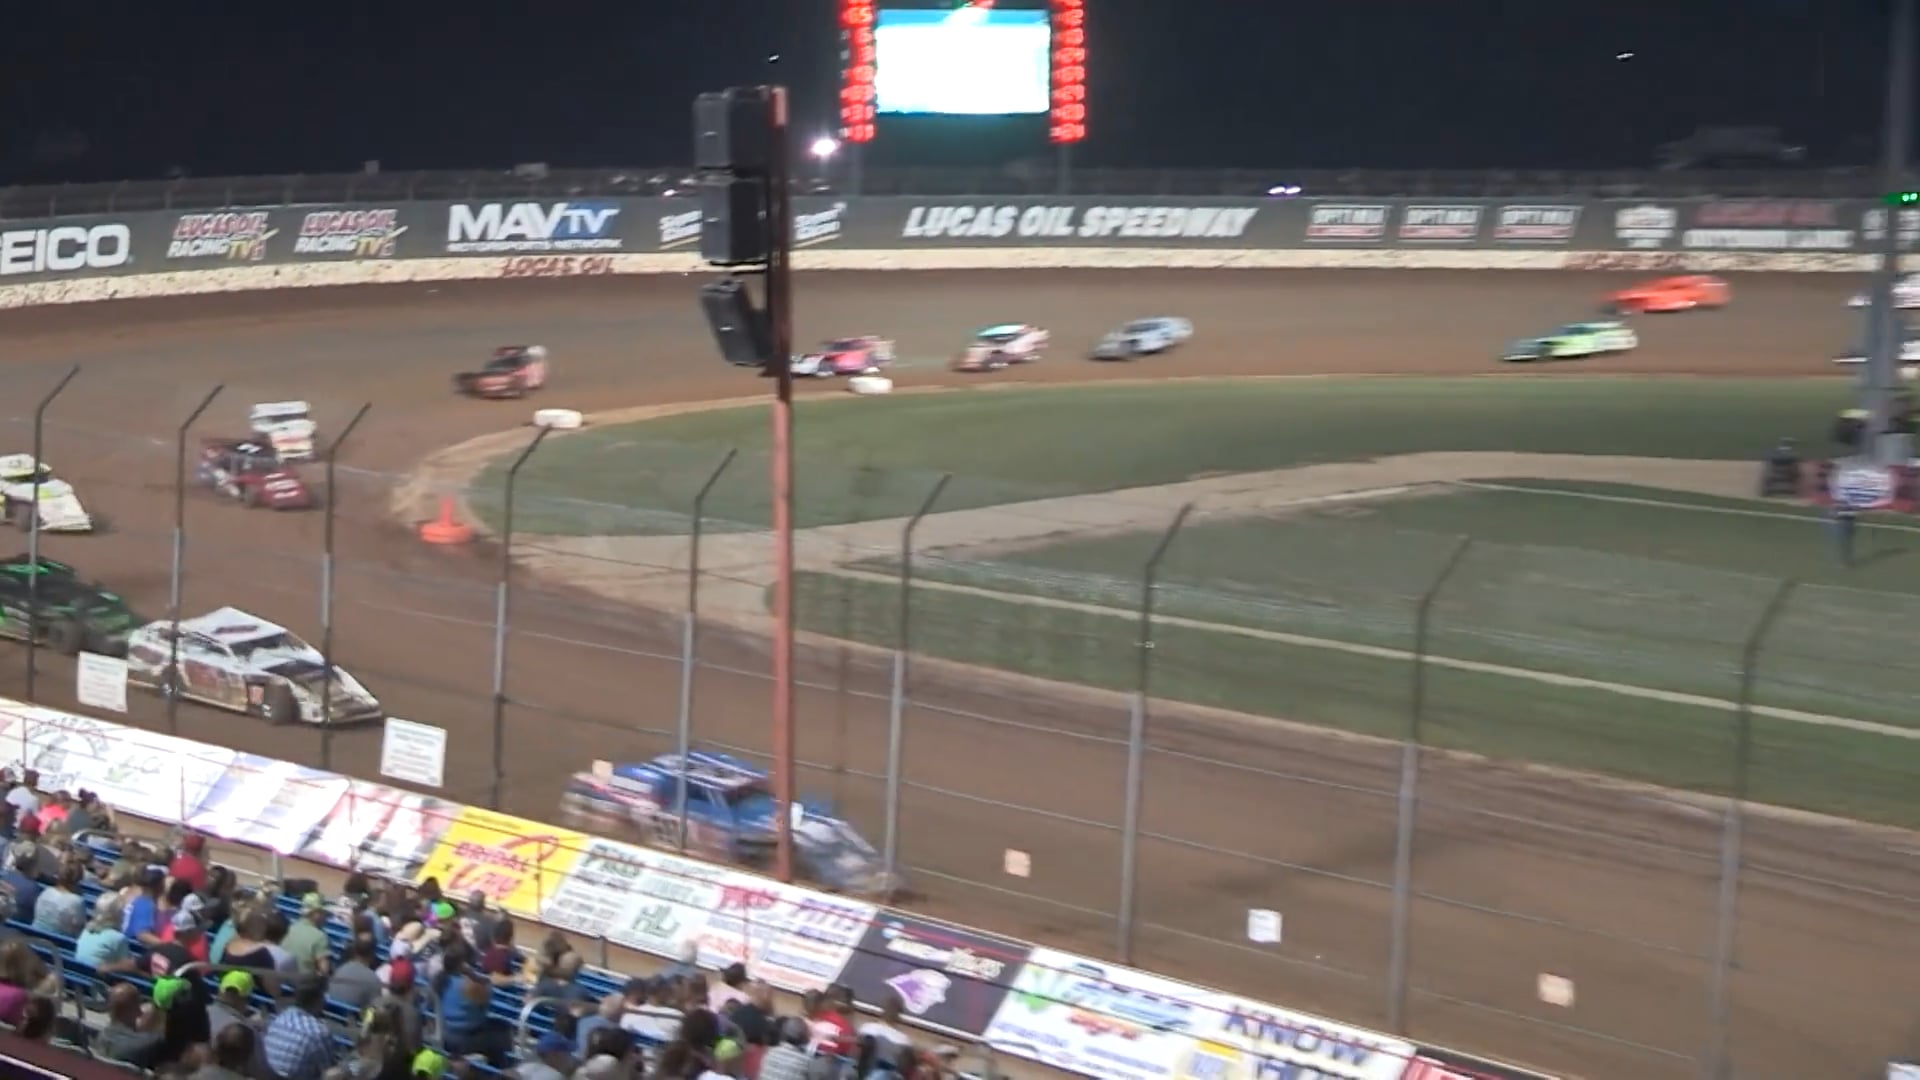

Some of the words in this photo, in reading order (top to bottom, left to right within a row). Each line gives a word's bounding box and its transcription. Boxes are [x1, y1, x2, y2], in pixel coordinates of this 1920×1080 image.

[902, 205, 1019, 238] LUCAS
[1017, 205, 1076, 238] OIL
[1076, 206, 1260, 238] SPEEDWAY
[0, 224, 130, 275] EICO
